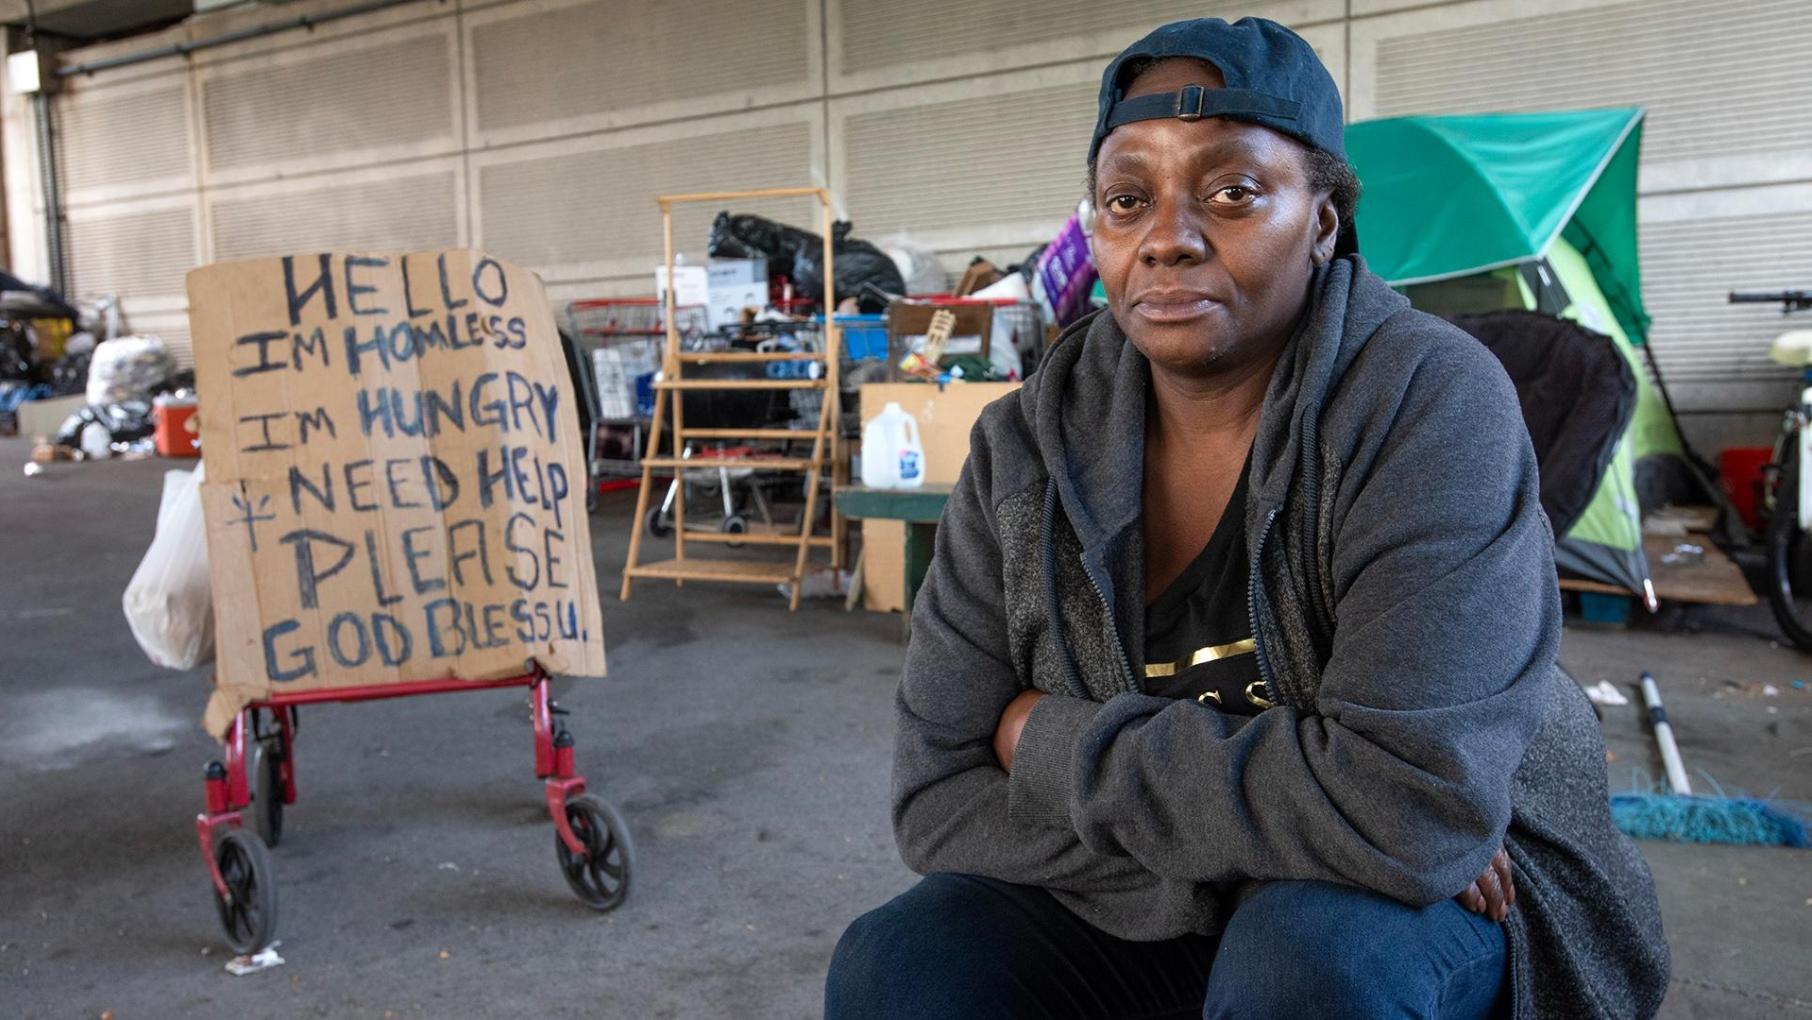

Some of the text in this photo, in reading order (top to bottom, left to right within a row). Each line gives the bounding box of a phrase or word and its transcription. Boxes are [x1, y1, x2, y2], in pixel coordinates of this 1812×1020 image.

[282, 253, 508, 326] HELLO
[232, 313, 527, 377] IM HOMLESS
[357, 371, 559, 444] HUNGRY
[289, 446, 569, 529] NEED HELP
[280, 512, 569, 609] PLEASE
[263, 612, 413, 682] GOD
